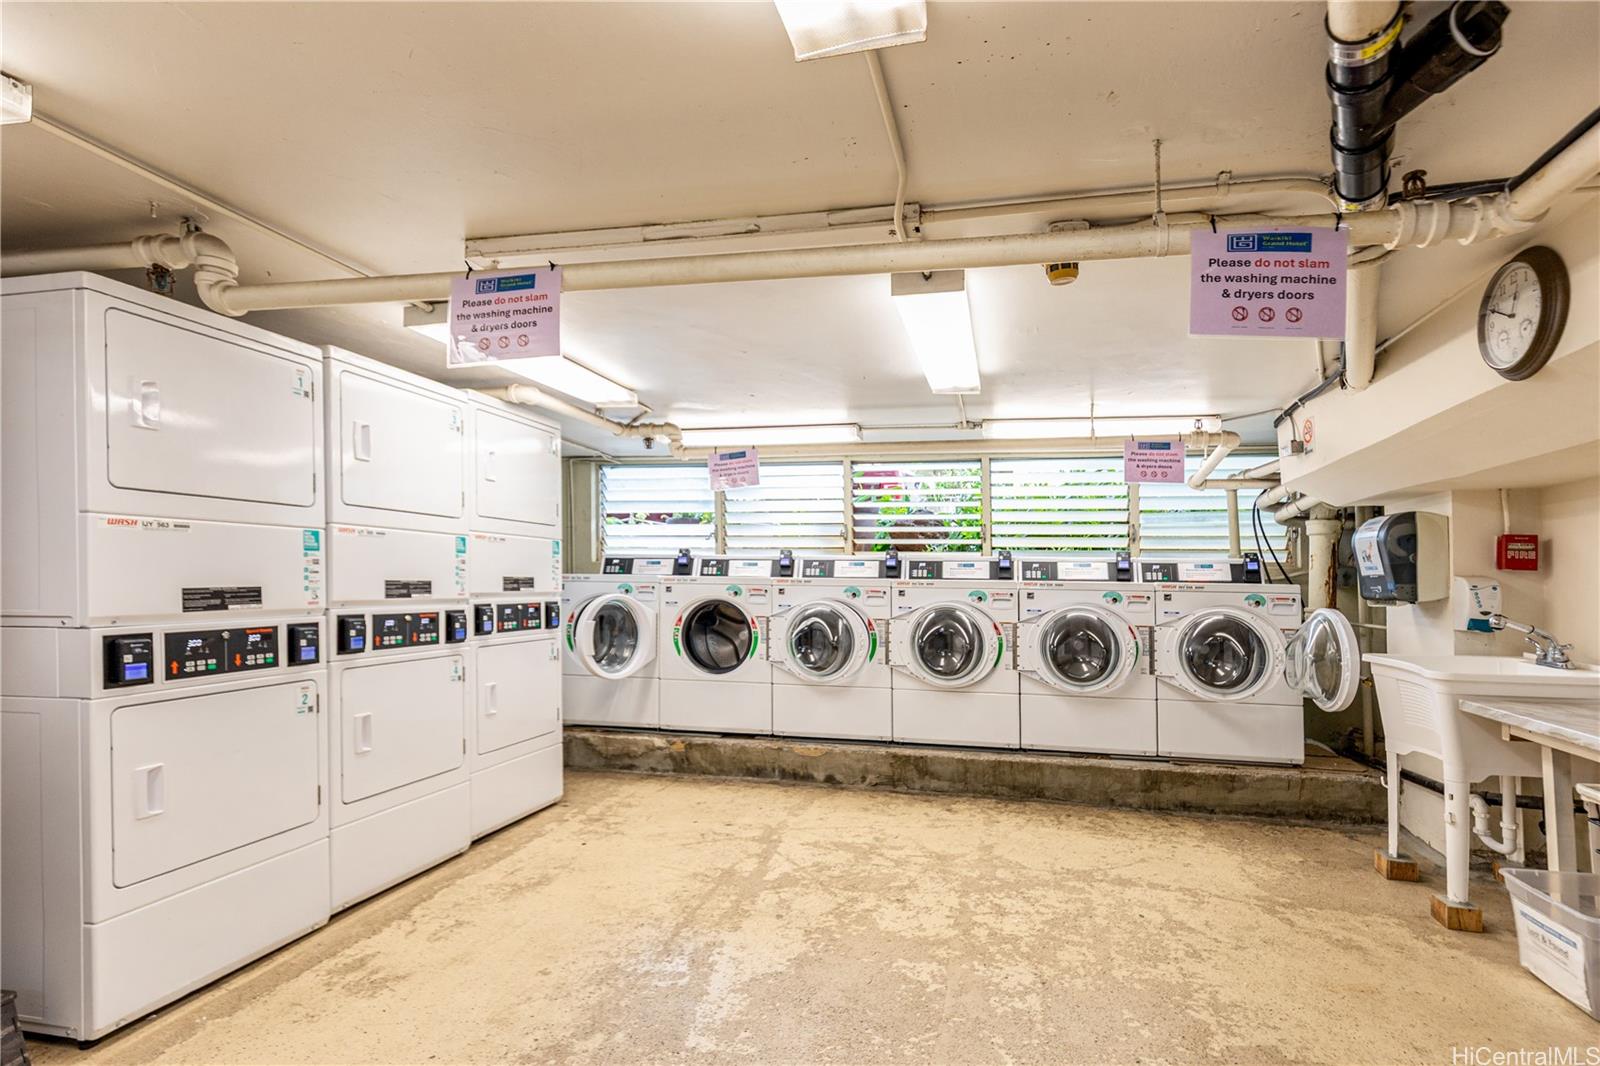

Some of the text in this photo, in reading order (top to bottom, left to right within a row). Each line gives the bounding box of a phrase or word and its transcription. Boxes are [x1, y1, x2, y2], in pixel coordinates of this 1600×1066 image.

[1208, 258, 1330, 269] Please do not slam
[1200, 273, 1337, 286] the washing machine
[462, 293, 548, 308] Please do not slam
[1221, 289, 1315, 301] & dryers doors
[456, 305, 553, 321] the washing machine
[471, 320, 538, 333] & dryers doors
[107, 517, 138, 526] WASH
[1507, 550, 1536, 559] FIRE
[302, 693, 308, 705] 2
